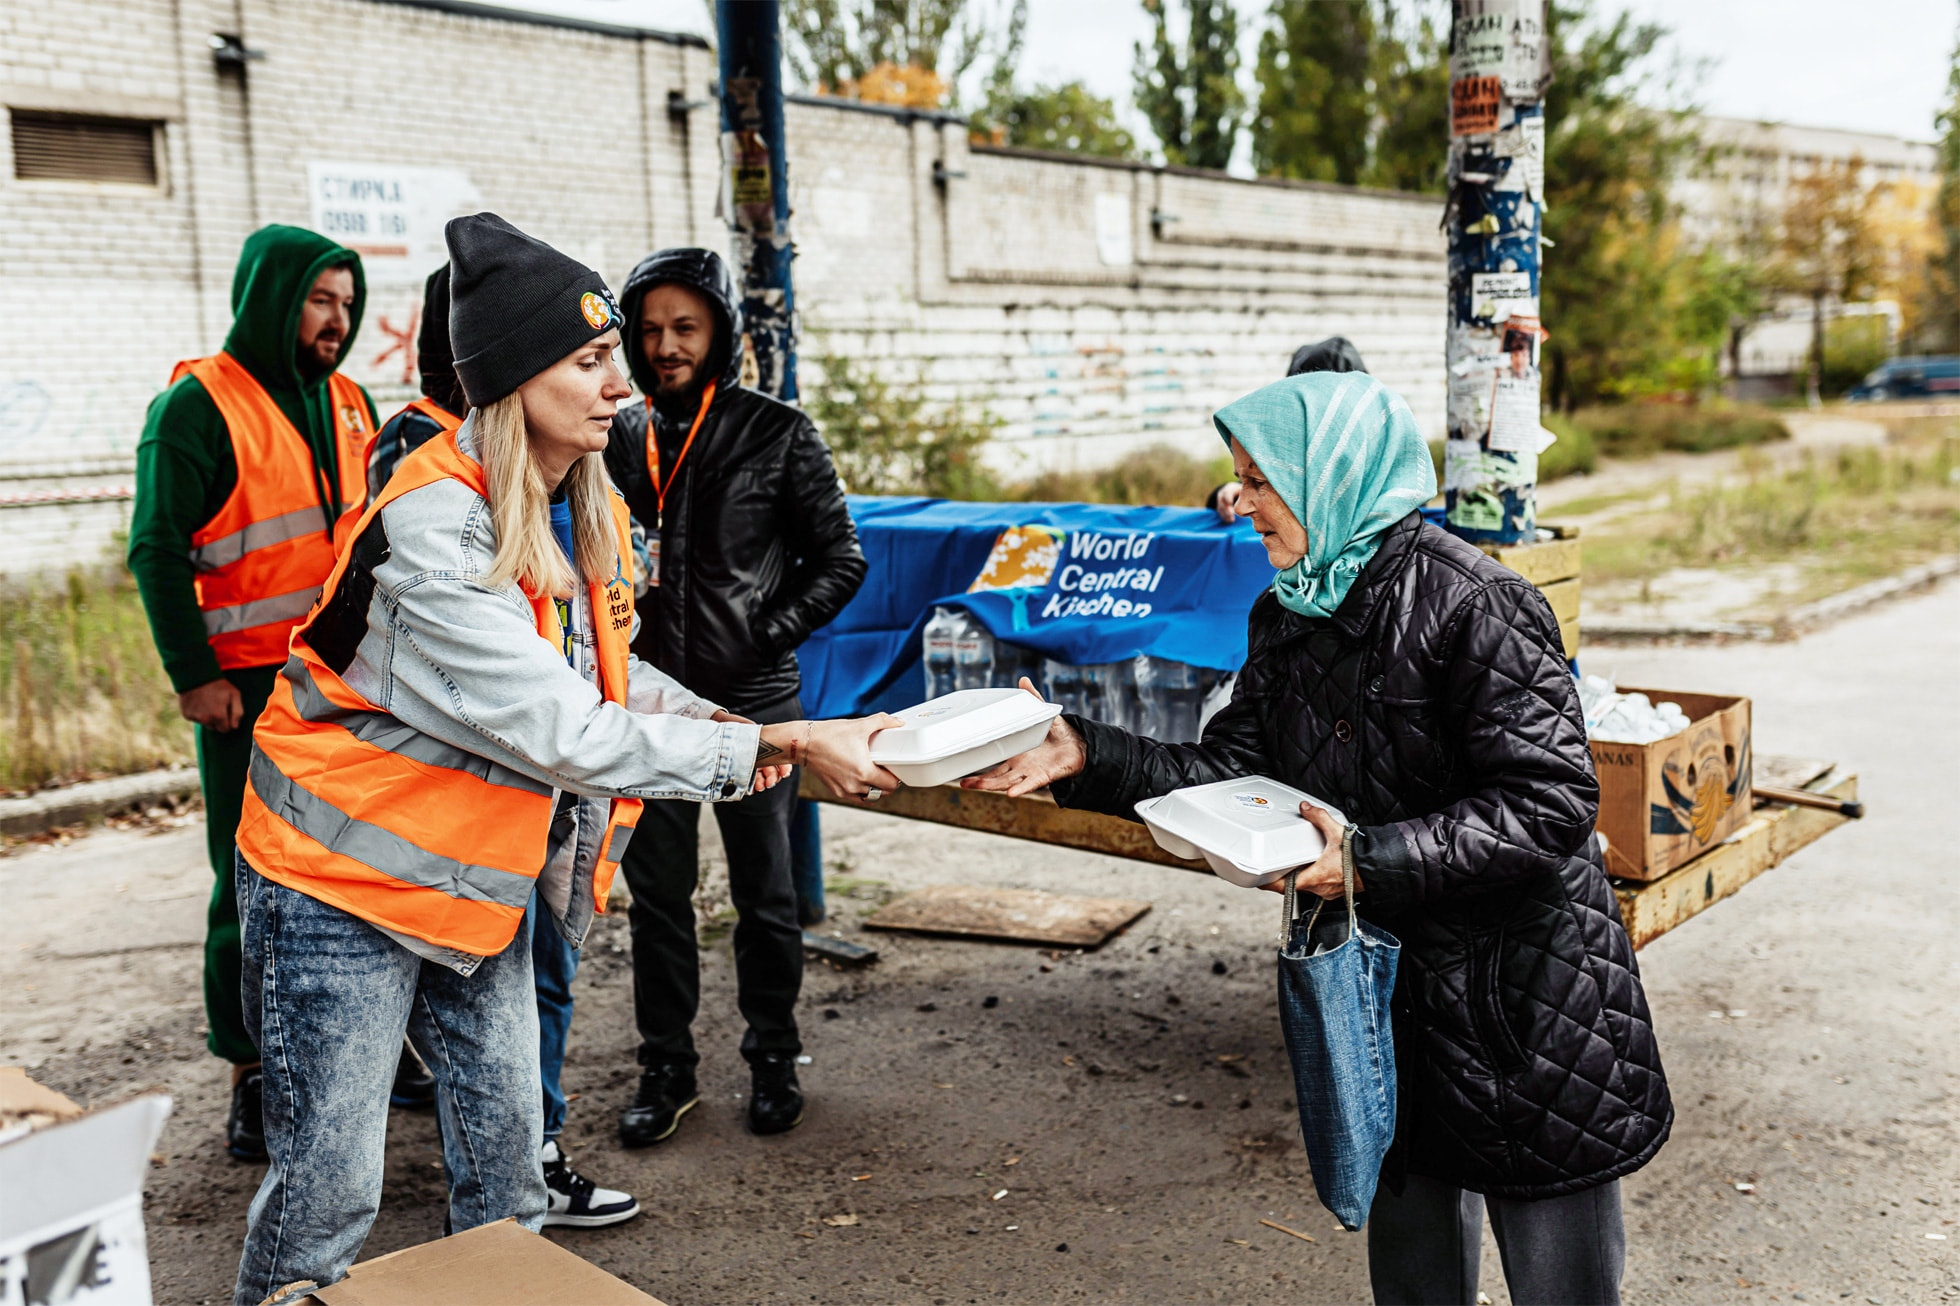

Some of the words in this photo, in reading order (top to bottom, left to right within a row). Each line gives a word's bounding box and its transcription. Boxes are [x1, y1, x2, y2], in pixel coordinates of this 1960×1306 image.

[1070, 531, 1155, 560] World
[1058, 564, 1165, 592] Central
[609, 599, 630, 617] tral
[1041, 592, 1152, 618] Kitchen
[1594, 752, 1634, 766] ANAS
